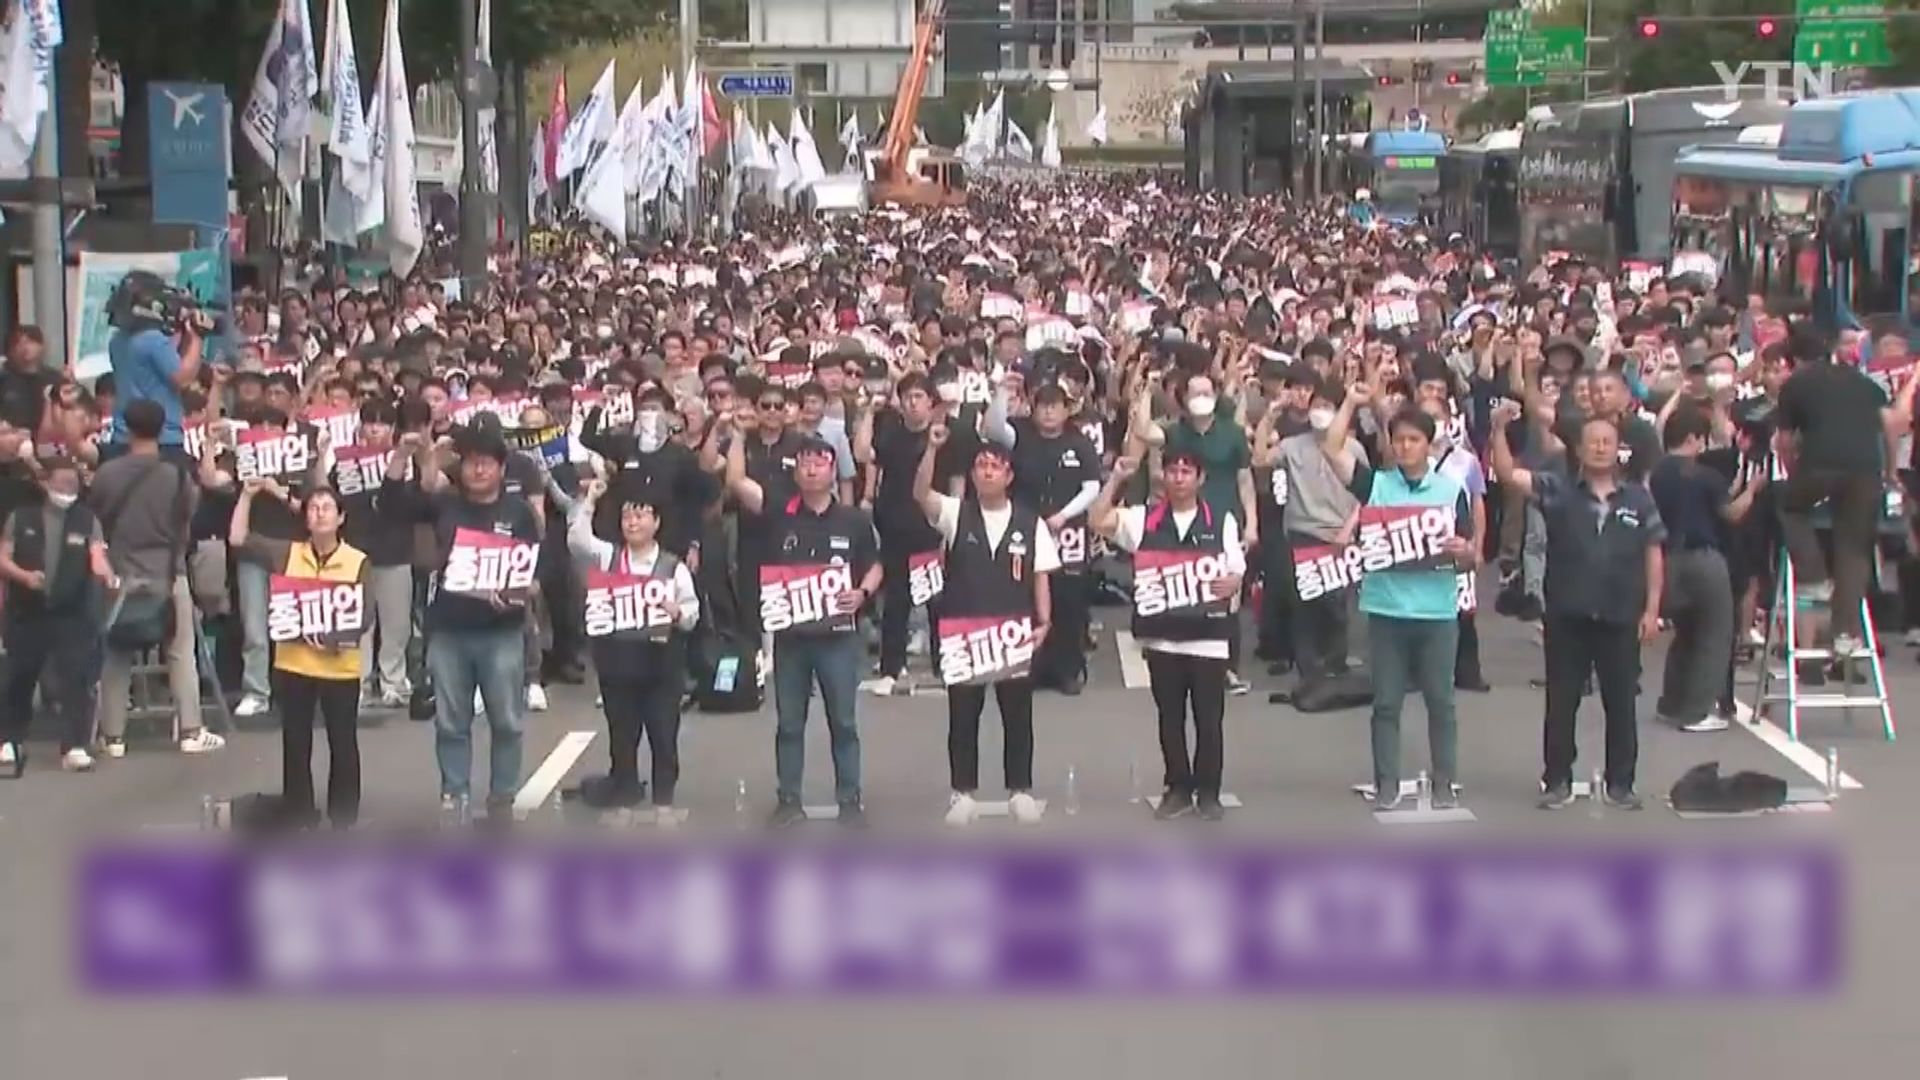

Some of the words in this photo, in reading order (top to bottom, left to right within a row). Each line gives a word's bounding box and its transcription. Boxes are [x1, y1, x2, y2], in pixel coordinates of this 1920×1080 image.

[235, 434, 308, 481] 총파업
[336, 451, 414, 496] 총파
[443, 543, 541, 592] 총파업
[1360, 507, 1456, 572] 총파업
[268, 583, 364, 642] 총파업
[584, 579, 676, 637] 총파업
[759, 563, 851, 632] 총파업
[1133, 551, 1230, 617] 총파업
[939, 617, 1034, 685] 총파업
